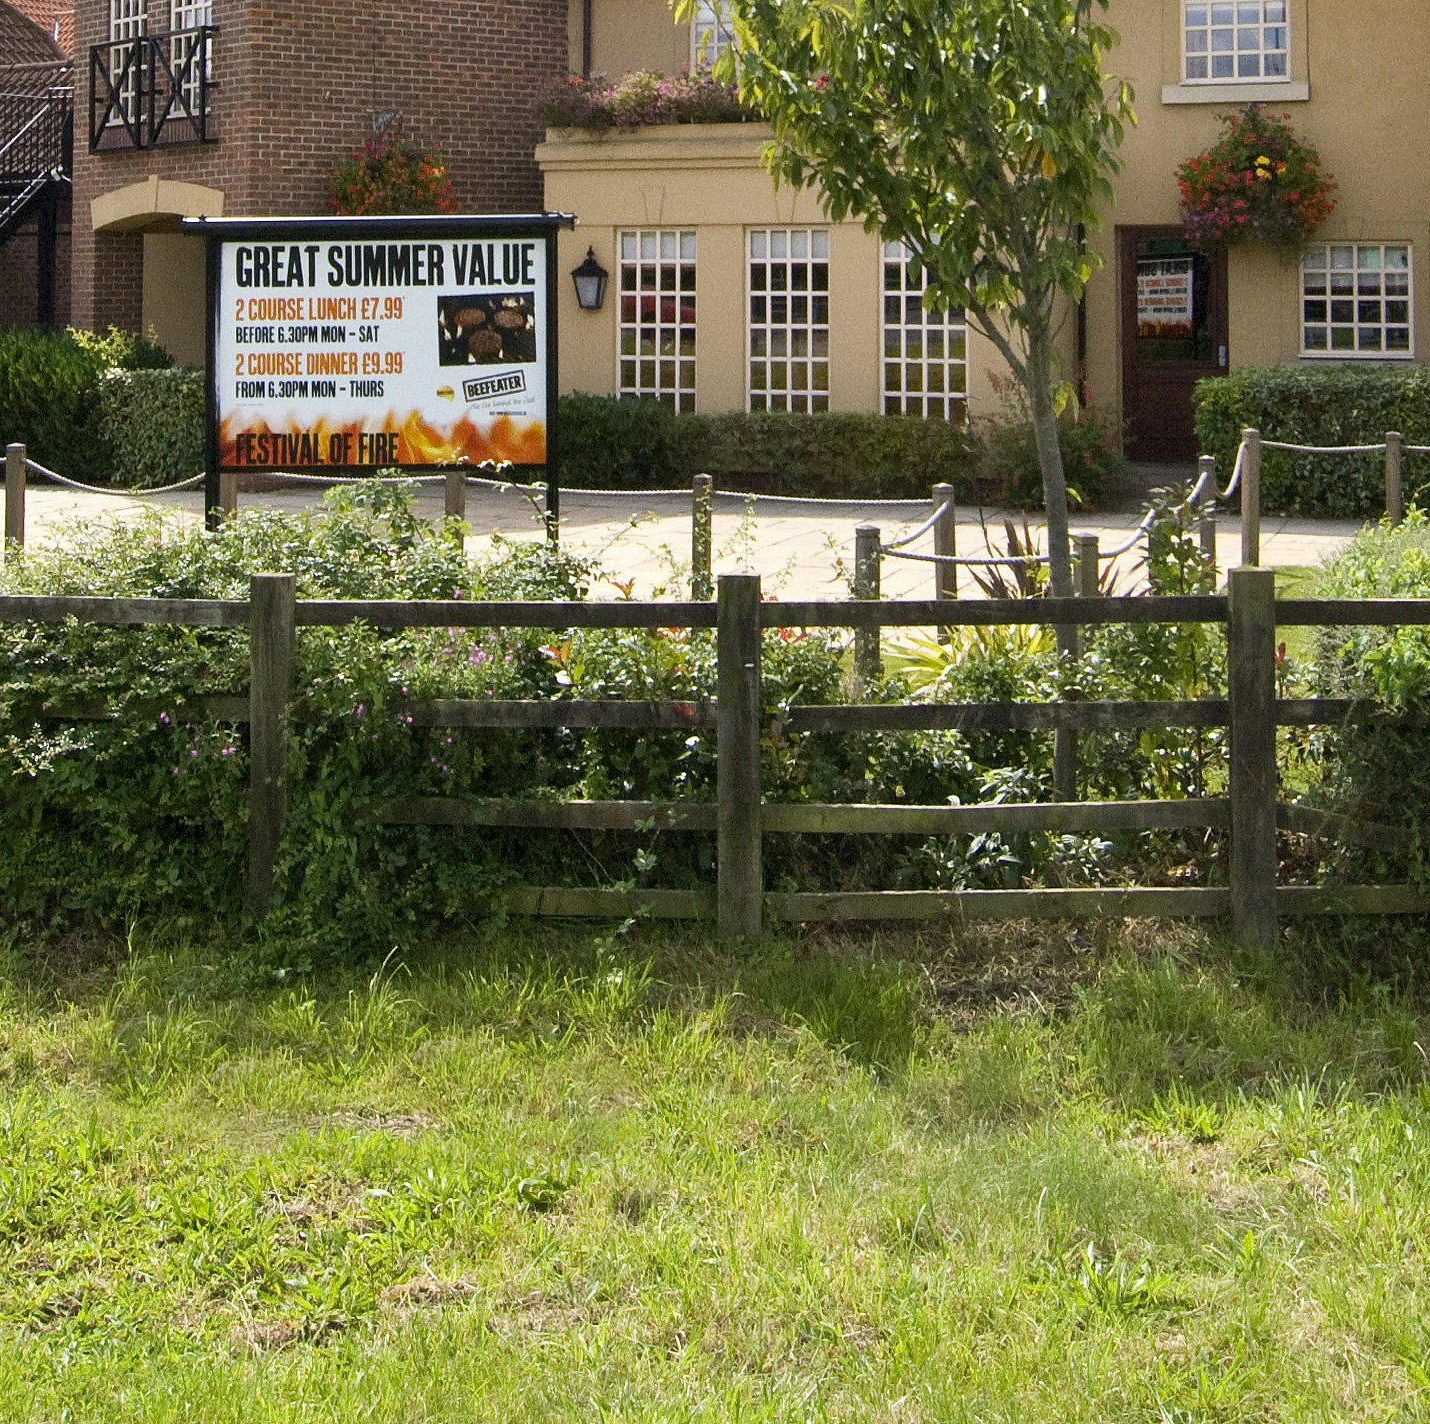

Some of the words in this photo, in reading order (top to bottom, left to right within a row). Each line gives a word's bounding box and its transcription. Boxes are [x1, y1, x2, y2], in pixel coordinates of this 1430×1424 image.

[235, 245, 320, 288] GREAT
[327, 244, 444, 287] SUMMER
[452, 243, 535, 286] VALUE
[235, 298, 245, 321] 2
[248, 298, 304, 321] COURSE
[309, 297, 356, 320] LUNCH
[235, 326, 275, 343] BEFORE
[277, 326, 318, 343] 6.30PM
[321, 326, 346, 342] MON
[359, 326, 380, 342] SAT
[235, 353, 245, 376] 2
[247, 353, 303, 375] COURSE
[306, 352, 358, 375] DINNER
[235, 381, 265, 398] FROM
[268, 381, 308, 398] 6.30PM
[311, 381, 336, 398] MON
[349, 381, 384, 397] THURS
[467, 375, 522, 397] BEEFEATER
[235, 431, 324, 465] FESTIVAL
[329, 432, 353, 465] OF
[358, 432, 399, 464] FIRE
